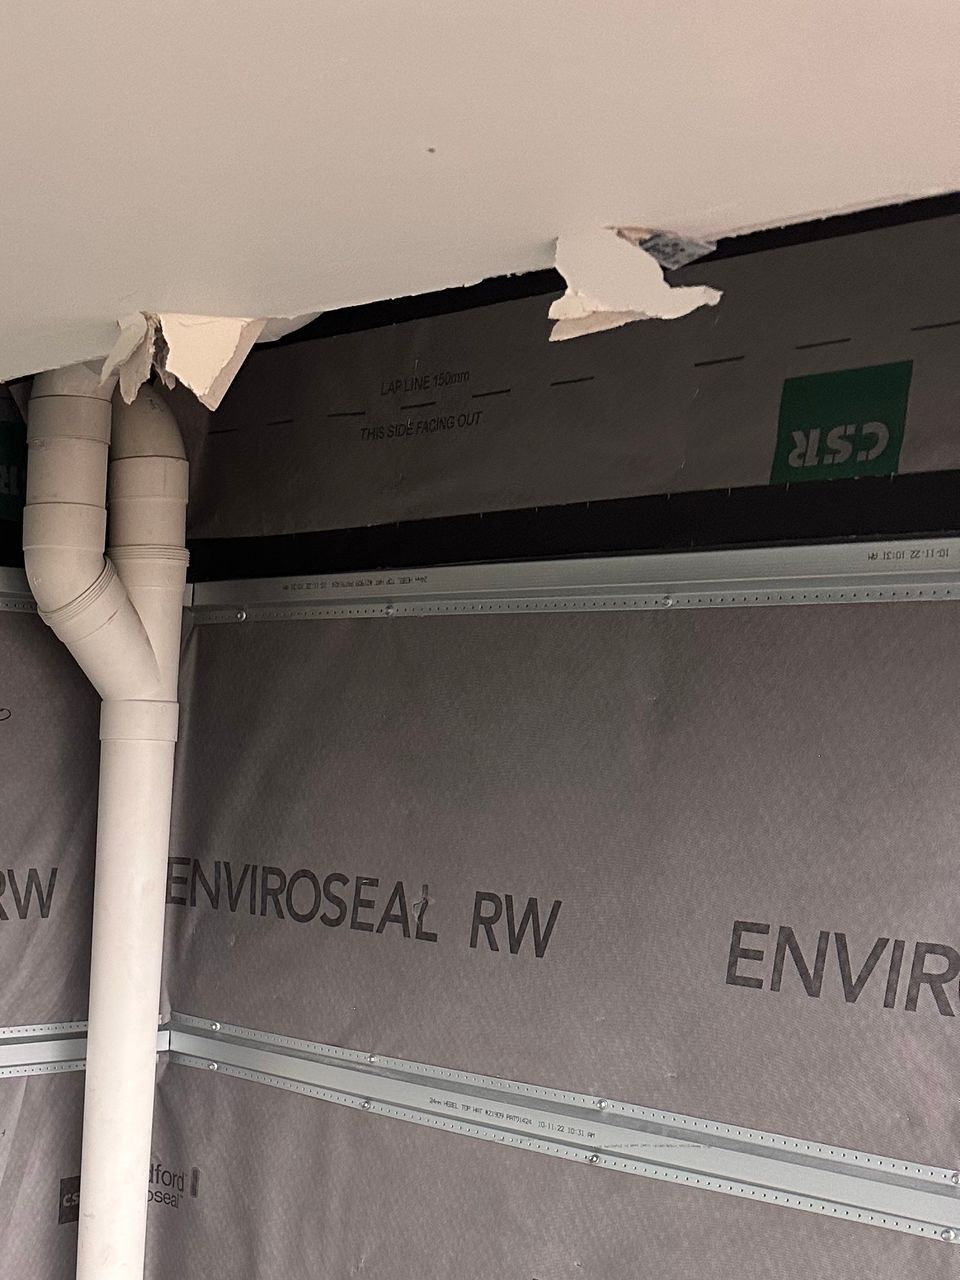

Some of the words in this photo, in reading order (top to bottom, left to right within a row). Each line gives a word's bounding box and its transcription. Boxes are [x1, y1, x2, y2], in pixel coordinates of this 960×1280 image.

[360, 425, 385, 441] THIS
[387, 421, 415, 439] SIDE
[415, 416, 456, 436] FACING
[457, 411, 483, 428] OUT
[788, 421, 890, 468] CSR
[165, 856, 439, 943] ENVIROSEAL
[469, 889, 563, 959] RW
[726, 920, 960, 1018] ENVIR
